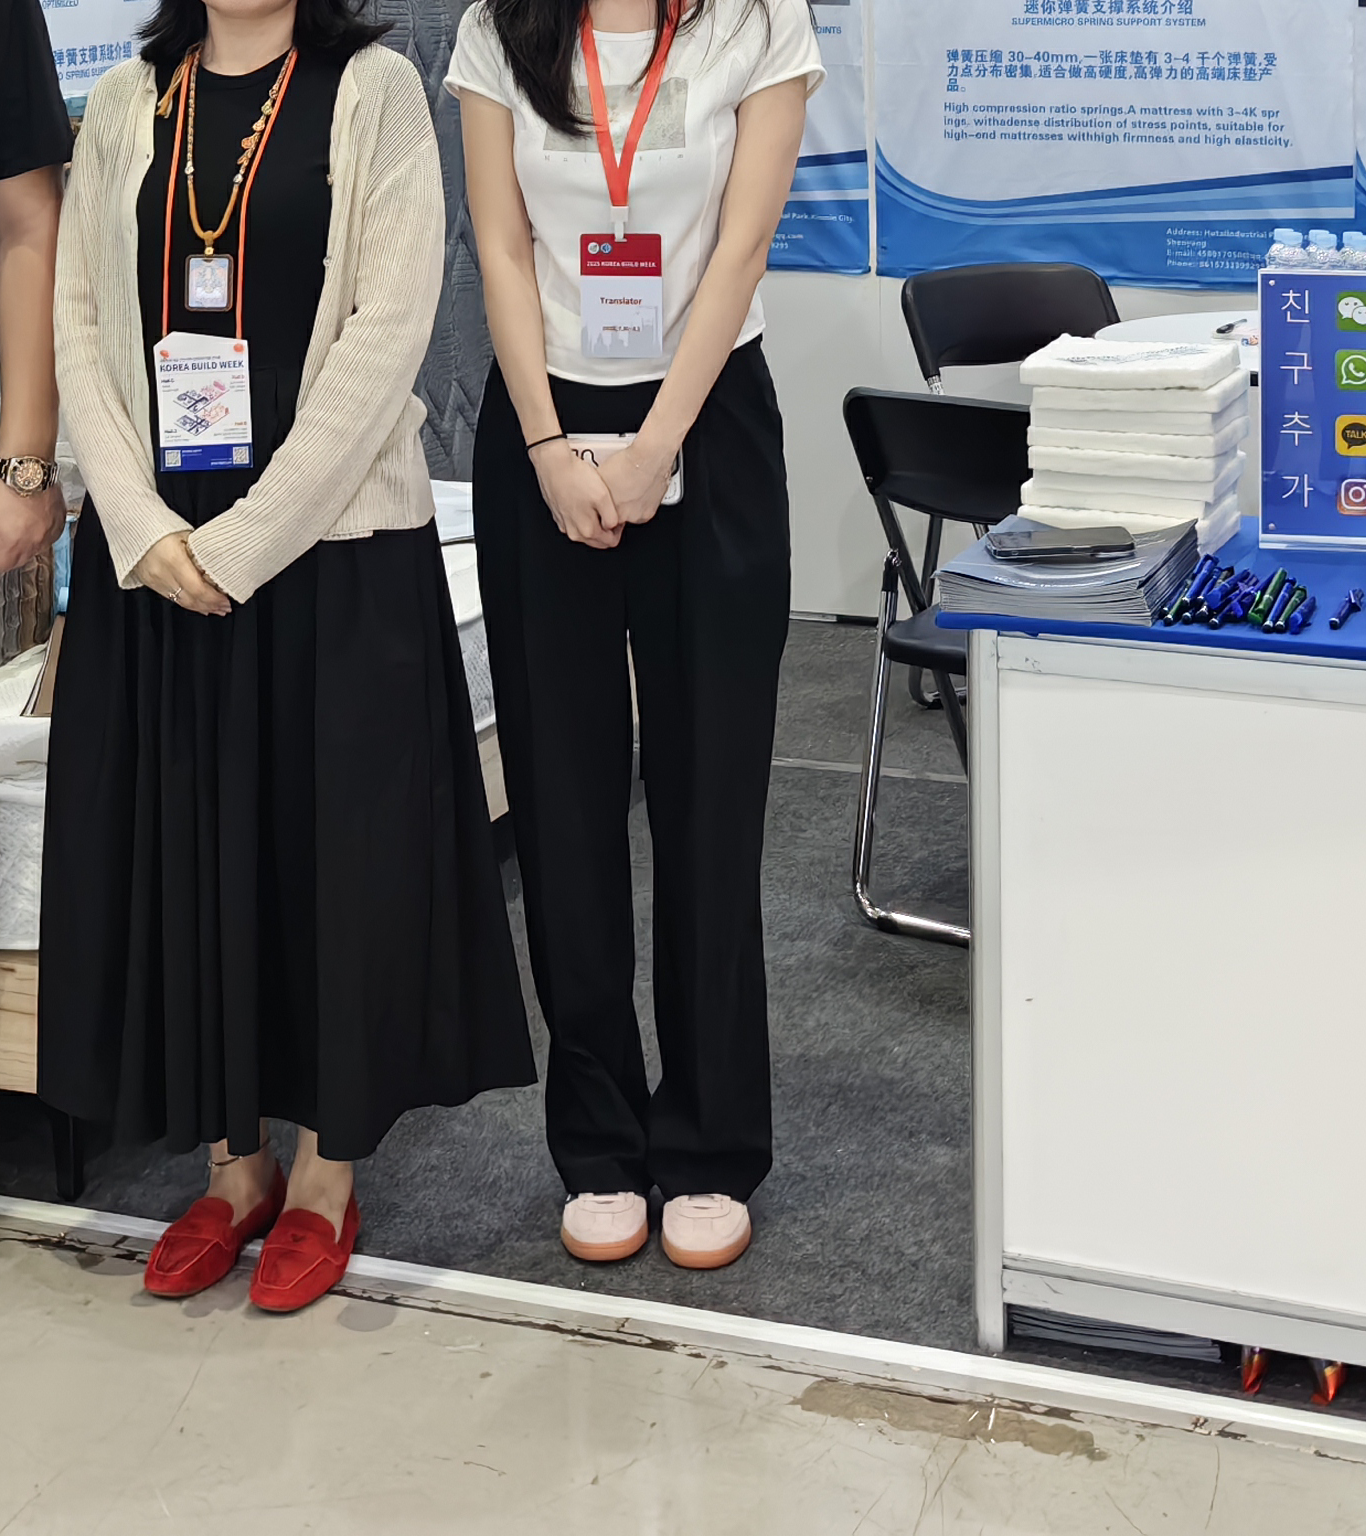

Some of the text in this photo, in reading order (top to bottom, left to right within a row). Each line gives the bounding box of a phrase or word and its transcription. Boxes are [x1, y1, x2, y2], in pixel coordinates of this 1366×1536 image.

[1012, 17, 1206, 27] SUPERMICRO SPRING SUPPORT SYSTEM
[944, 102, 1077, 115] High compression ratio
[1044, 117, 1128, 129] distribution of
[1215, 121, 1264, 132] suitable
[1267, 122, 1285, 132] for
[1178, 133, 1200, 144] and
[1204, 133, 1231, 147] high
[600, 297, 642, 305] Translator
[160, 361, 244, 372] KOREA BUILD WEEK
